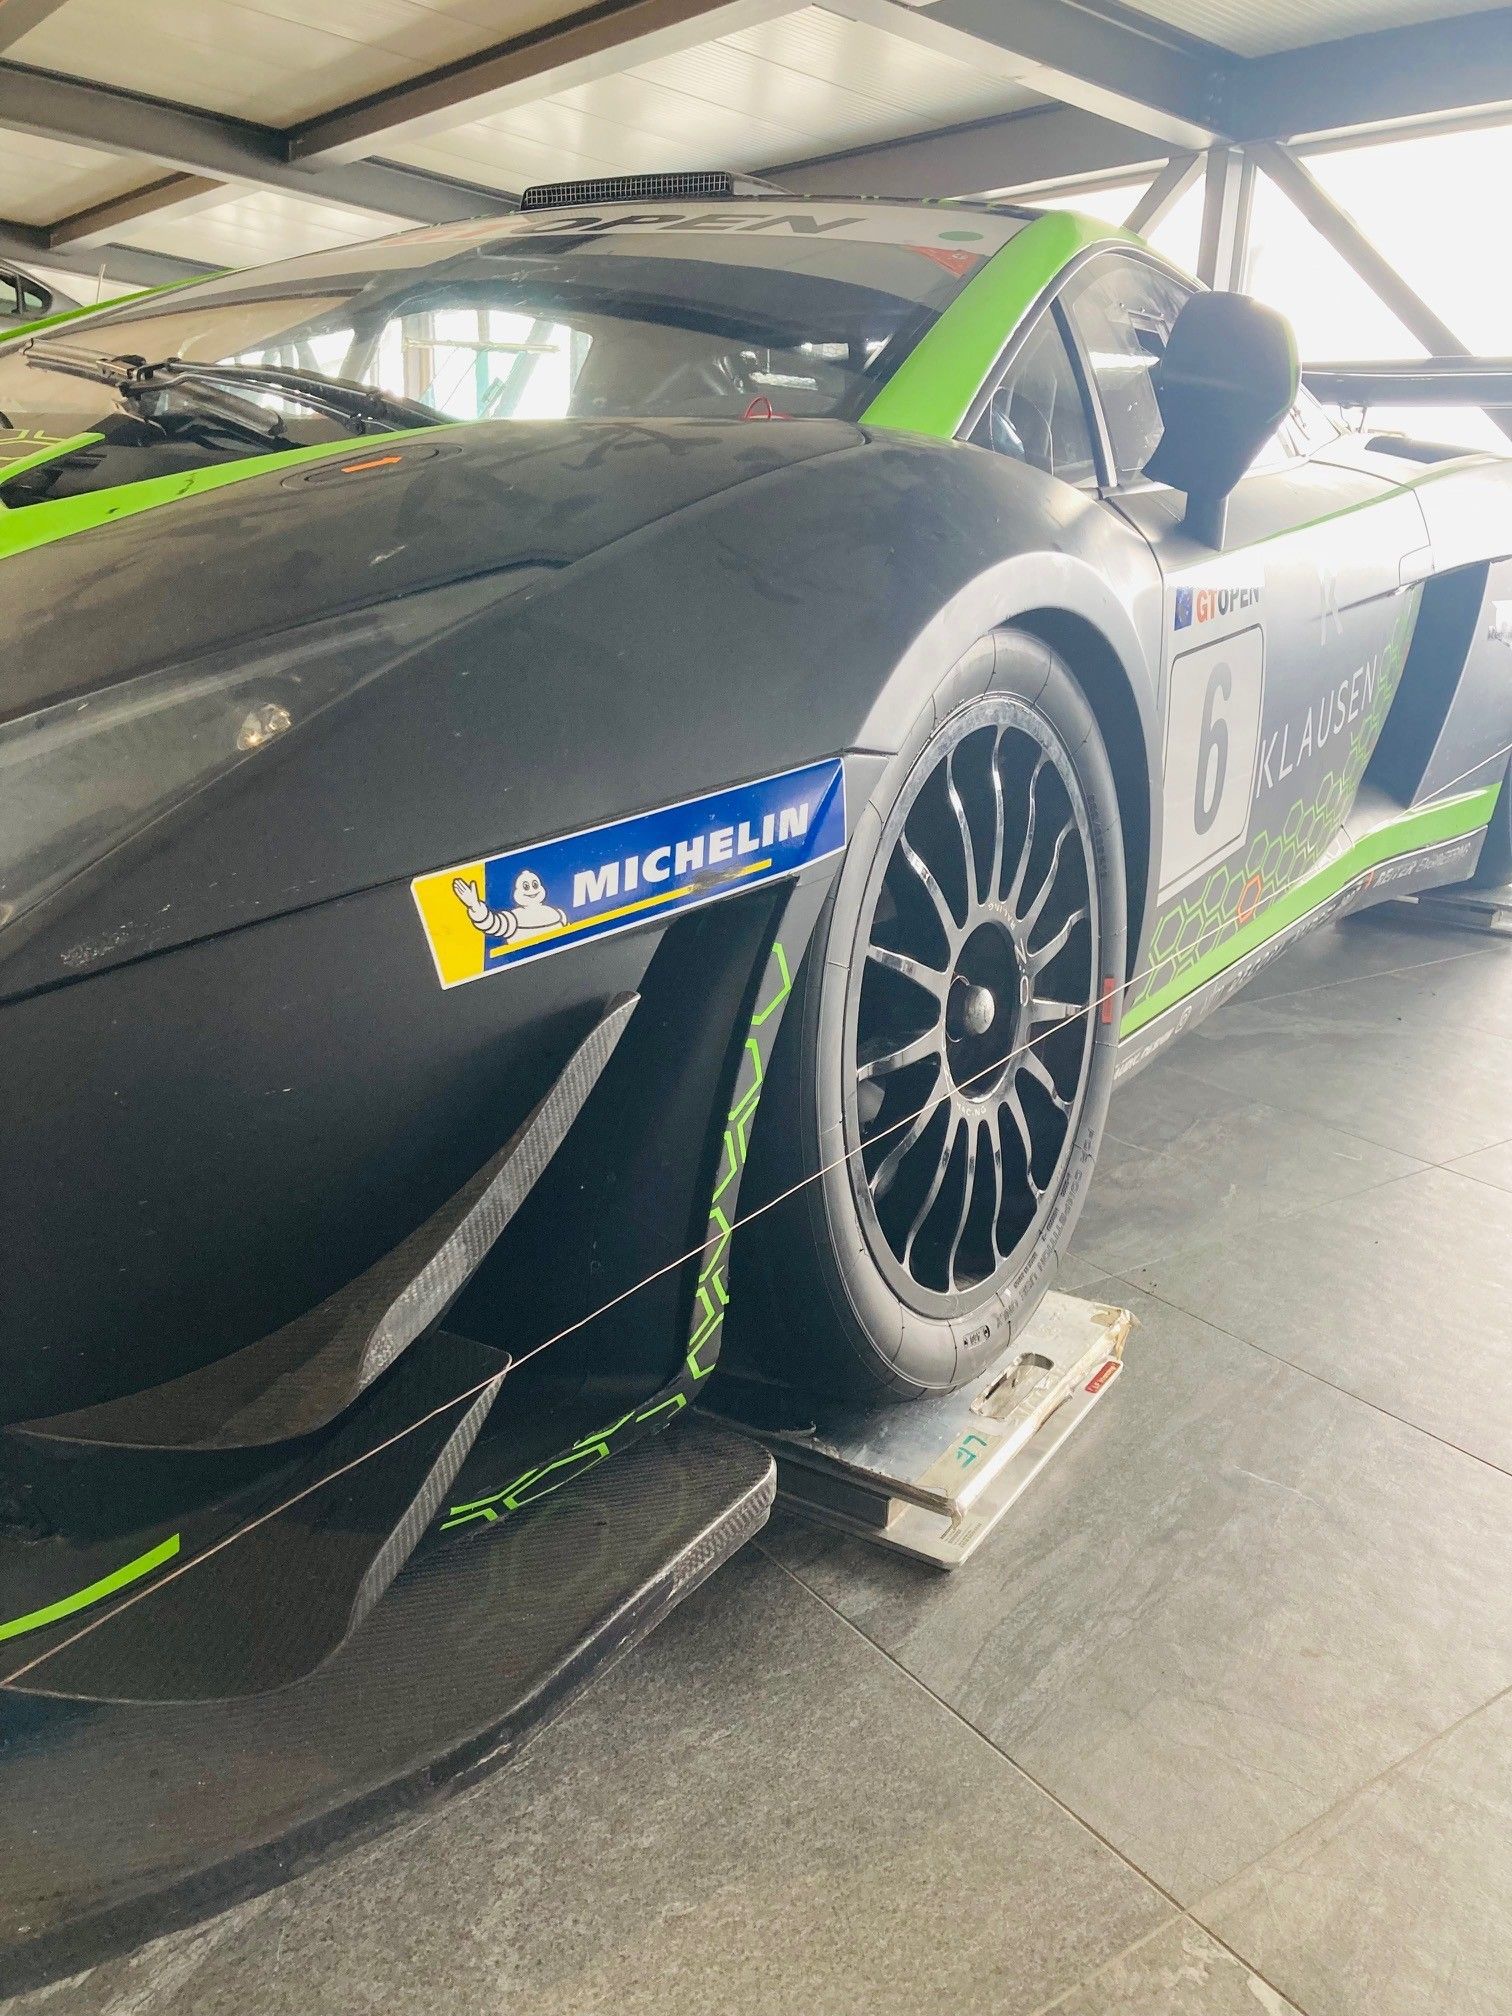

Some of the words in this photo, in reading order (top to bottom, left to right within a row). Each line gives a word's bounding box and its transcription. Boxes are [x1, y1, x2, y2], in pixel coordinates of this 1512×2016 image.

[1193, 661, 1232, 836] 6
[1256, 654, 1378, 799] KLAUSEN
[572, 801, 811, 908] MICHELIN
